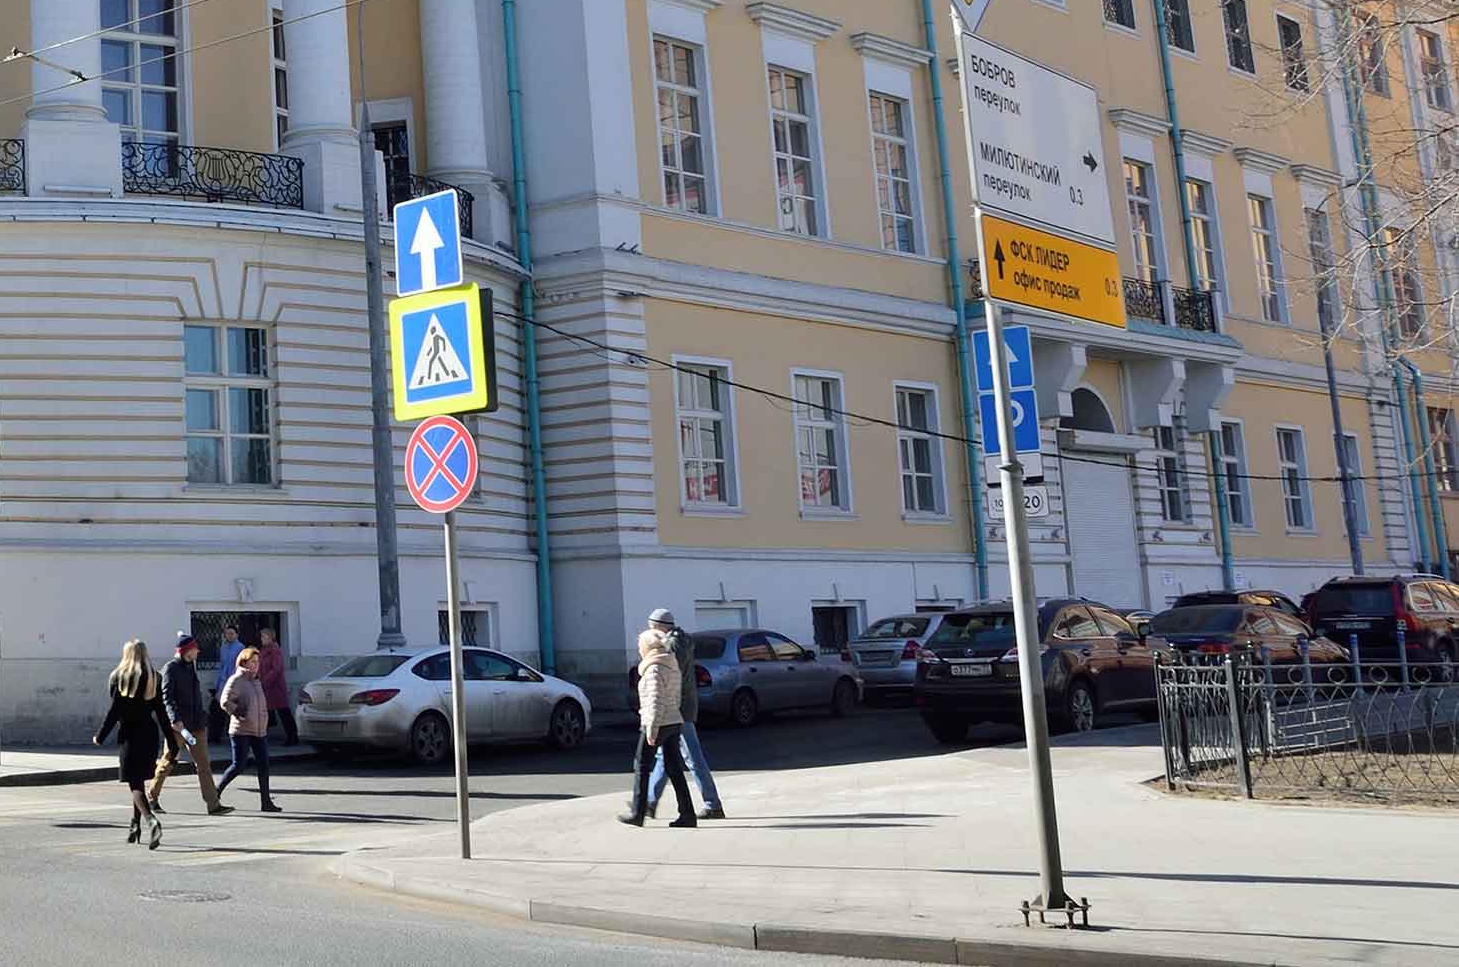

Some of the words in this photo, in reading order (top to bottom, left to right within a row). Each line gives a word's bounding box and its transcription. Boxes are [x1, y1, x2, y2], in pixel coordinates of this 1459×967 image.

[971, 54, 1016, 89] БОБРОВ
[974, 85, 1021, 117] переулок
[980, 141, 1061, 187] МИЛЮТИНСКИЙ
[983, 172, 1032, 202] переулок
[1069, 185, 1084, 207] 0.3
[1010, 239, 1034, 263] ФСК
[1036, 244, 1070, 273] ЛИДЕР
[1013, 269, 1042, 293] офис
[1043, 276, 1081, 301] продаж
[1104, 277, 1118, 298] 0.3
[1023, 495, 1041, 509] 20
